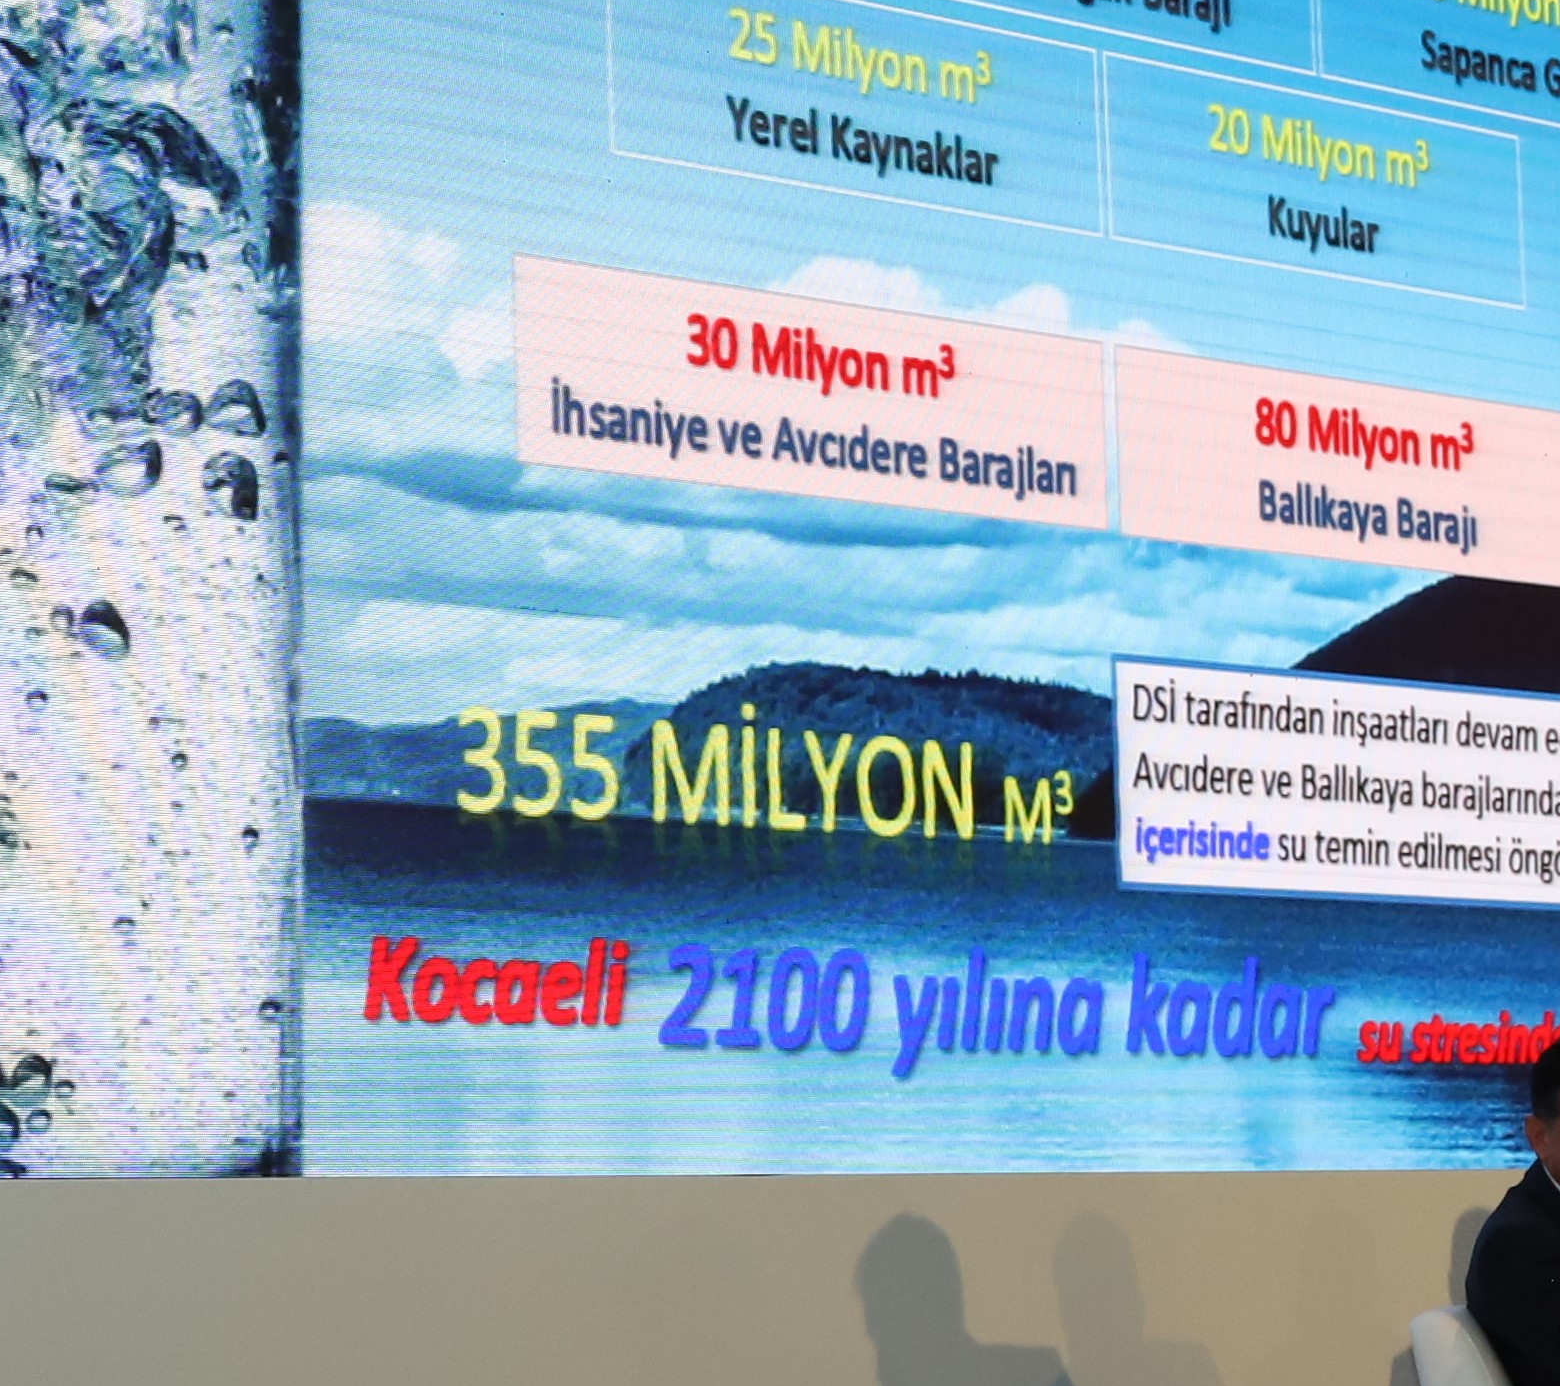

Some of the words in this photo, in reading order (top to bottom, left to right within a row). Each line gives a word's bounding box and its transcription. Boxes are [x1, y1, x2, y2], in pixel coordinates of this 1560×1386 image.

[728, 7, 778, 65] 25
[792, 20, 928, 95] Milyon
[1421, 30, 1537, 92] Sapanca
[726, 94, 818, 155] Yerel
[831, 113, 999, 185] Kaynaklar
[1208, 103, 1250, 155] 20
[1262, 114, 1376, 181] Milyon
[1268, 194, 1380, 254] Kuyular
[686, 313, 738, 370] 30
[752, 322, 890, 397] Milyon
[550, 377, 710, 459] İhsaniye
[717, 419, 762, 458] ve
[772, 416, 927, 479] Avcıdere
[1255, 397, 1297, 449] 80
[1308, 404, 1420, 471] Milyon
[1259, 479, 1388, 543] Ballıkaya
[1397, 497, 1478, 556] Barajı
[1133, 679, 1175, 723] DSİ
[1184, 690, 1324, 735] tarafından
[1332, 699, 1448, 746] inşaatları
[1456, 711, 1537, 753] devam
[457, 705, 619, 820] 355
[652, 703, 975, 839] MİLYON
[1133, 752, 1253, 795] Avcıdere
[1261, 767, 1292, 799] ve
[1301, 764, 1413, 813] Ballıkaya
[1136, 817, 1270, 863] içerisinde
[1278, 833, 1306, 862] su
[1316, 829, 1389, 868] temin
[1397, 831, 1501, 874] edilmesi
[364, 934, 630, 1026] Kocaeli
[658, 943, 871, 1052] 2100
[891, 946, 1104, 1077] yılına
[1126, 951, 1336, 1057] kadar
[1357, 1019, 1403, 1064] su
